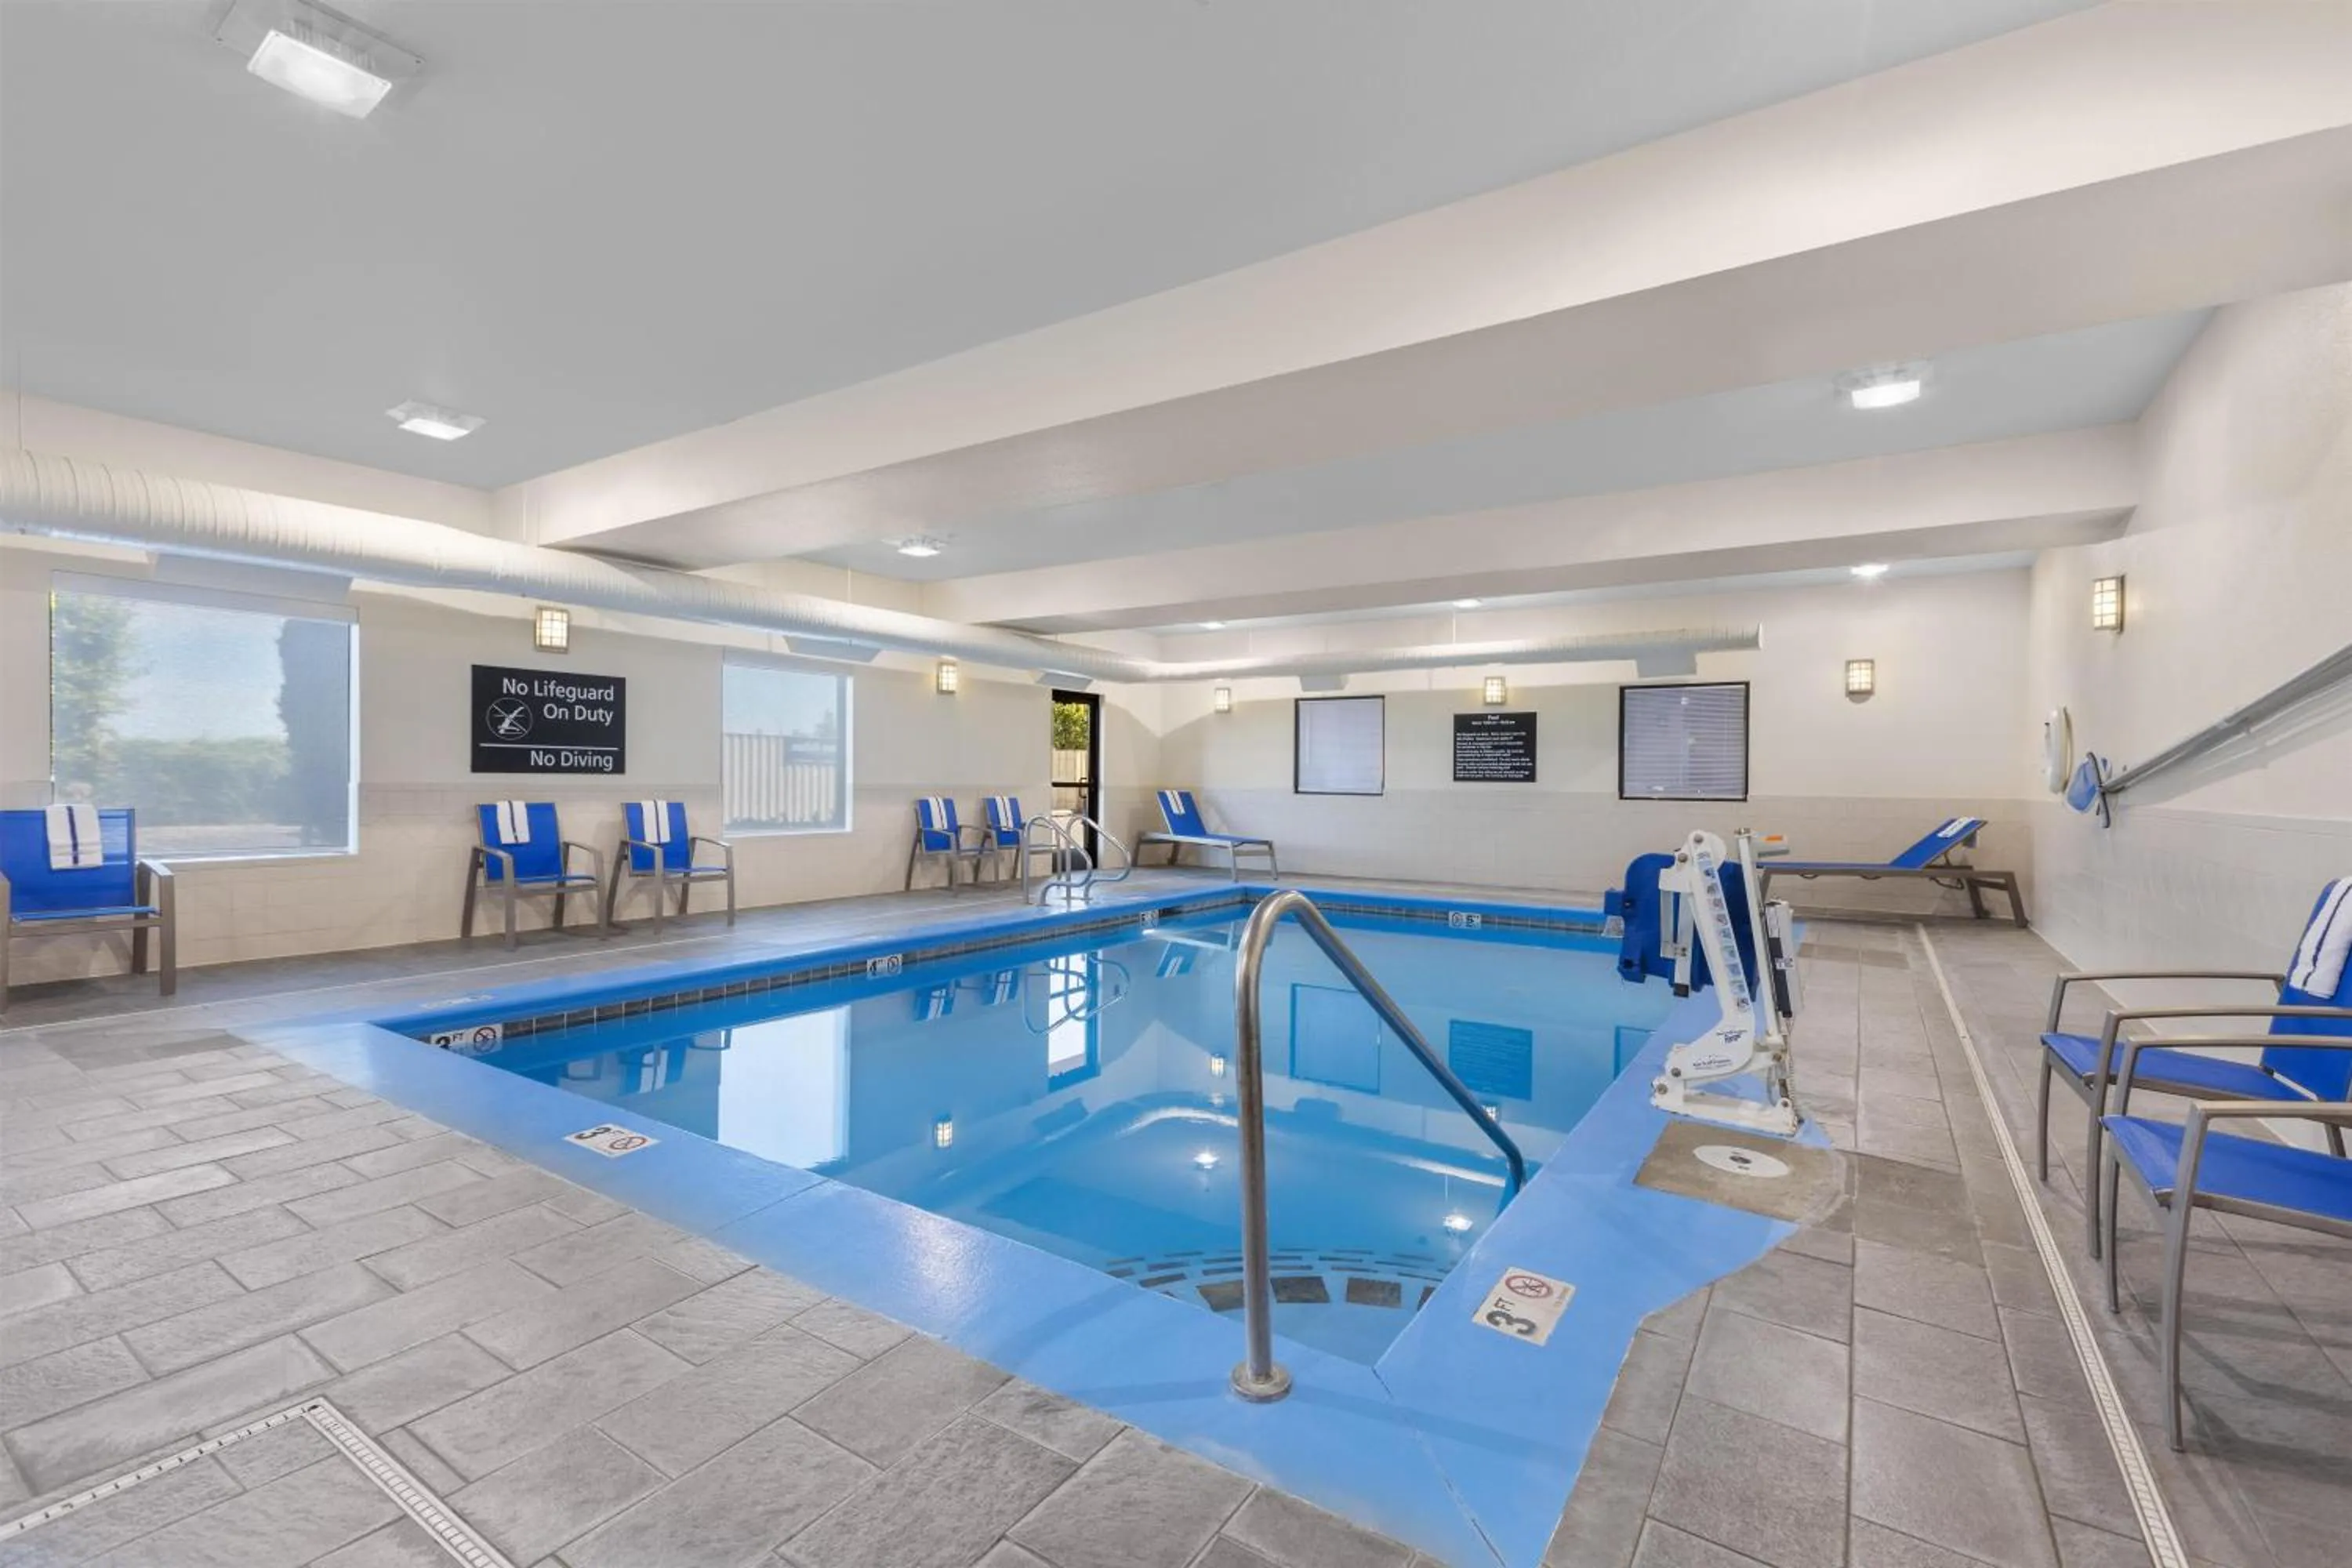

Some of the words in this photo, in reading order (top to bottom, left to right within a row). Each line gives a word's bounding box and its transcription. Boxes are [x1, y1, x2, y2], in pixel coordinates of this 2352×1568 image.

[503, 677, 528, 695] No
[534, 680, 614, 702] Lifeguard
[543, 703, 568, 720] On
[575, 705, 614, 726] Duty
[530, 750, 556, 767] No
[561, 750, 613, 771] Diving
[574, 1127, 612, 1140] 3
[1494, 1297, 1515, 1312] FT
[1486, 1310, 1537, 1336] 3
